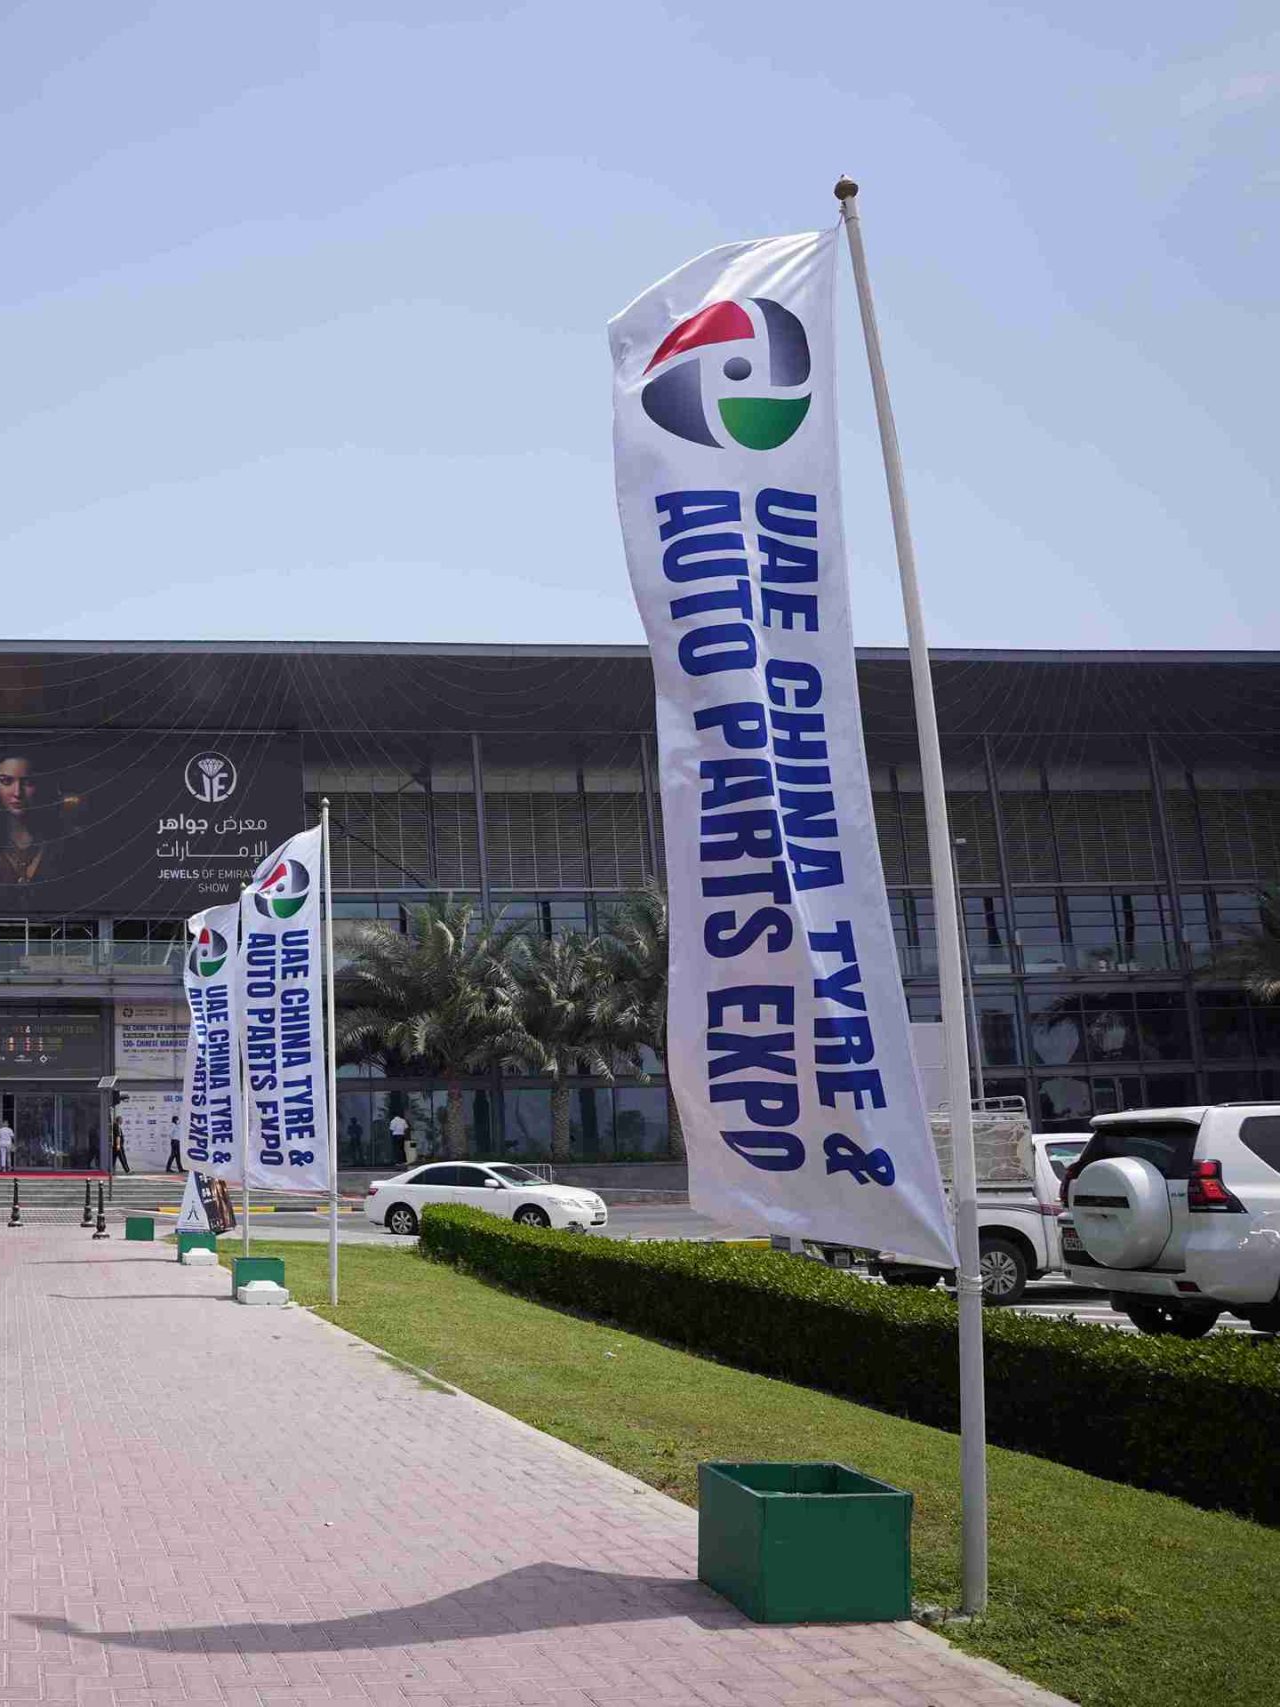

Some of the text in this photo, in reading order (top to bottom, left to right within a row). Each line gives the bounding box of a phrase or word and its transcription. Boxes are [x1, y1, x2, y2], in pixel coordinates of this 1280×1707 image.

[157, 813, 268, 835] معرض جواهر
[654, 490, 805, 1172] AUTO PARTS EXPO
[756, 487, 896, 1187] UAE CHINA TYRE &
[158, 869, 200, 879] JEWELS
[202, 869, 216, 879] OF
[198, 882, 230, 893] SHOW
[247, 933, 276, 998] AUTO
[206, 984, 234, 1164] UAE CHINA TYRE &
[248, 1008, 278, 1092] PARTS
[281, 929, 315, 1167] UAE CHINA TYRE &
[187, 1112, 209, 1162] EXPO
